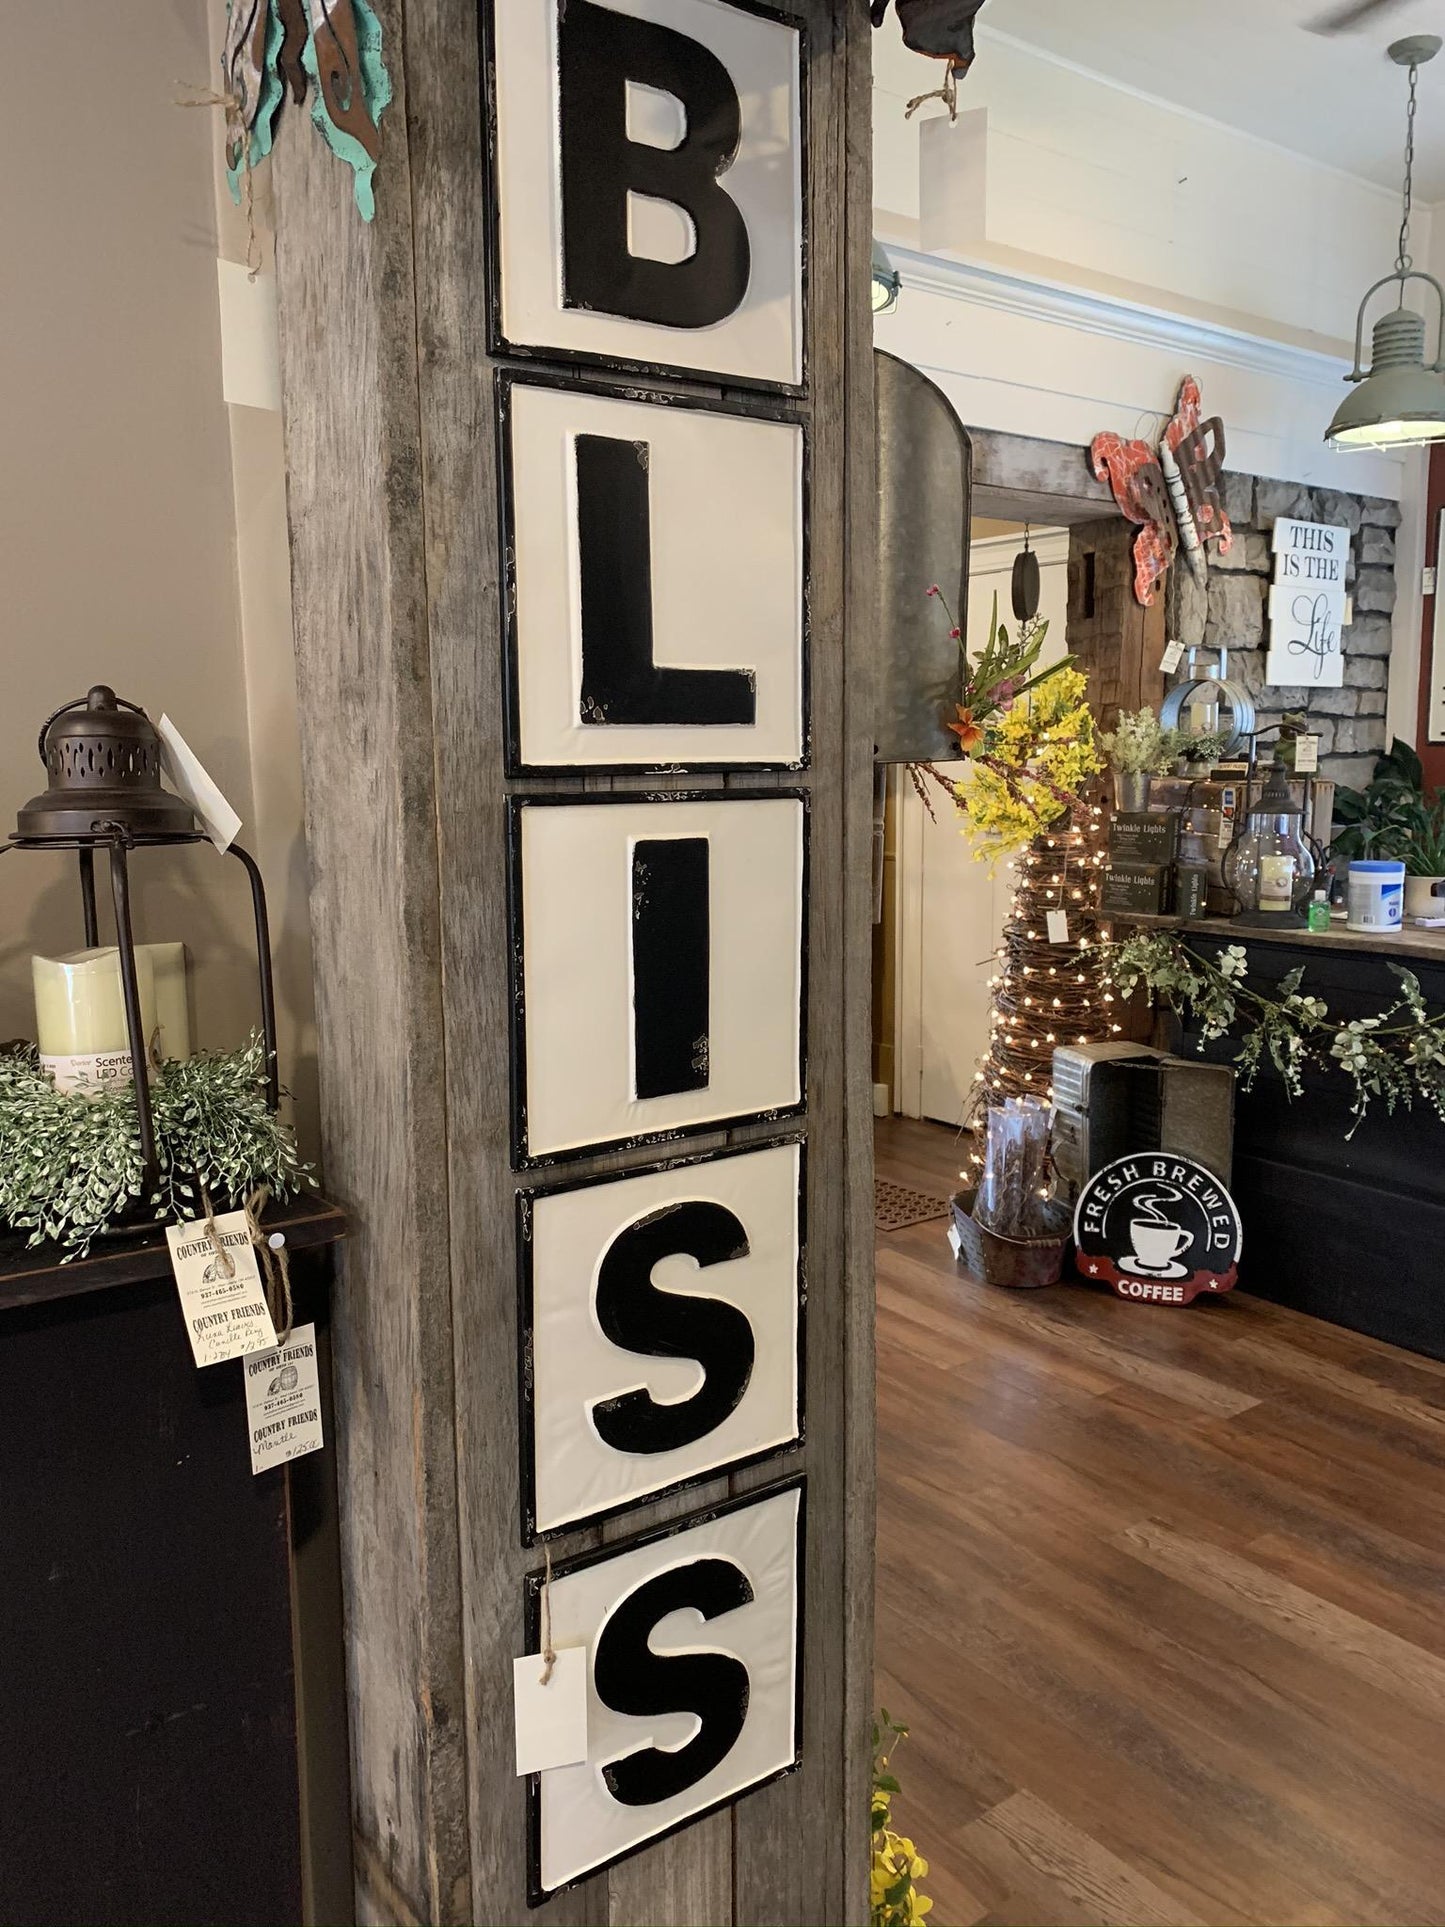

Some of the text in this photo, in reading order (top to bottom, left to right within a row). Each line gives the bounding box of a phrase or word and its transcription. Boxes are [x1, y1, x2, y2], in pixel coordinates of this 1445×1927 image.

[1290, 525, 1335, 553] THIS
[1283, 554, 1339, 581] IS THE
[1287, 593, 1338, 680] Life
[1112, 823, 1166, 834] Twinkle Lights
[1105, 873, 1155, 886] Twinkle Lights
[95, 1055, 135, 1068] Scente
[1084, 1163, 1140, 1233] FRESH
[1152, 1161, 1231, 1249] BREWED
[176, 1239, 213, 1260] COUNTRY
[218, 1231, 250, 1248] RIENDS
[1117, 1279, 1184, 1302] COFFEE
[193, 1302, 266, 1332] COUNTRY FRIENDS
[248, 1344, 314, 1377] COUNTRY FRIENDS
[253, 1419, 286, 1443] COUNTRY
[288, 1408, 318, 1427] FRIENDS
